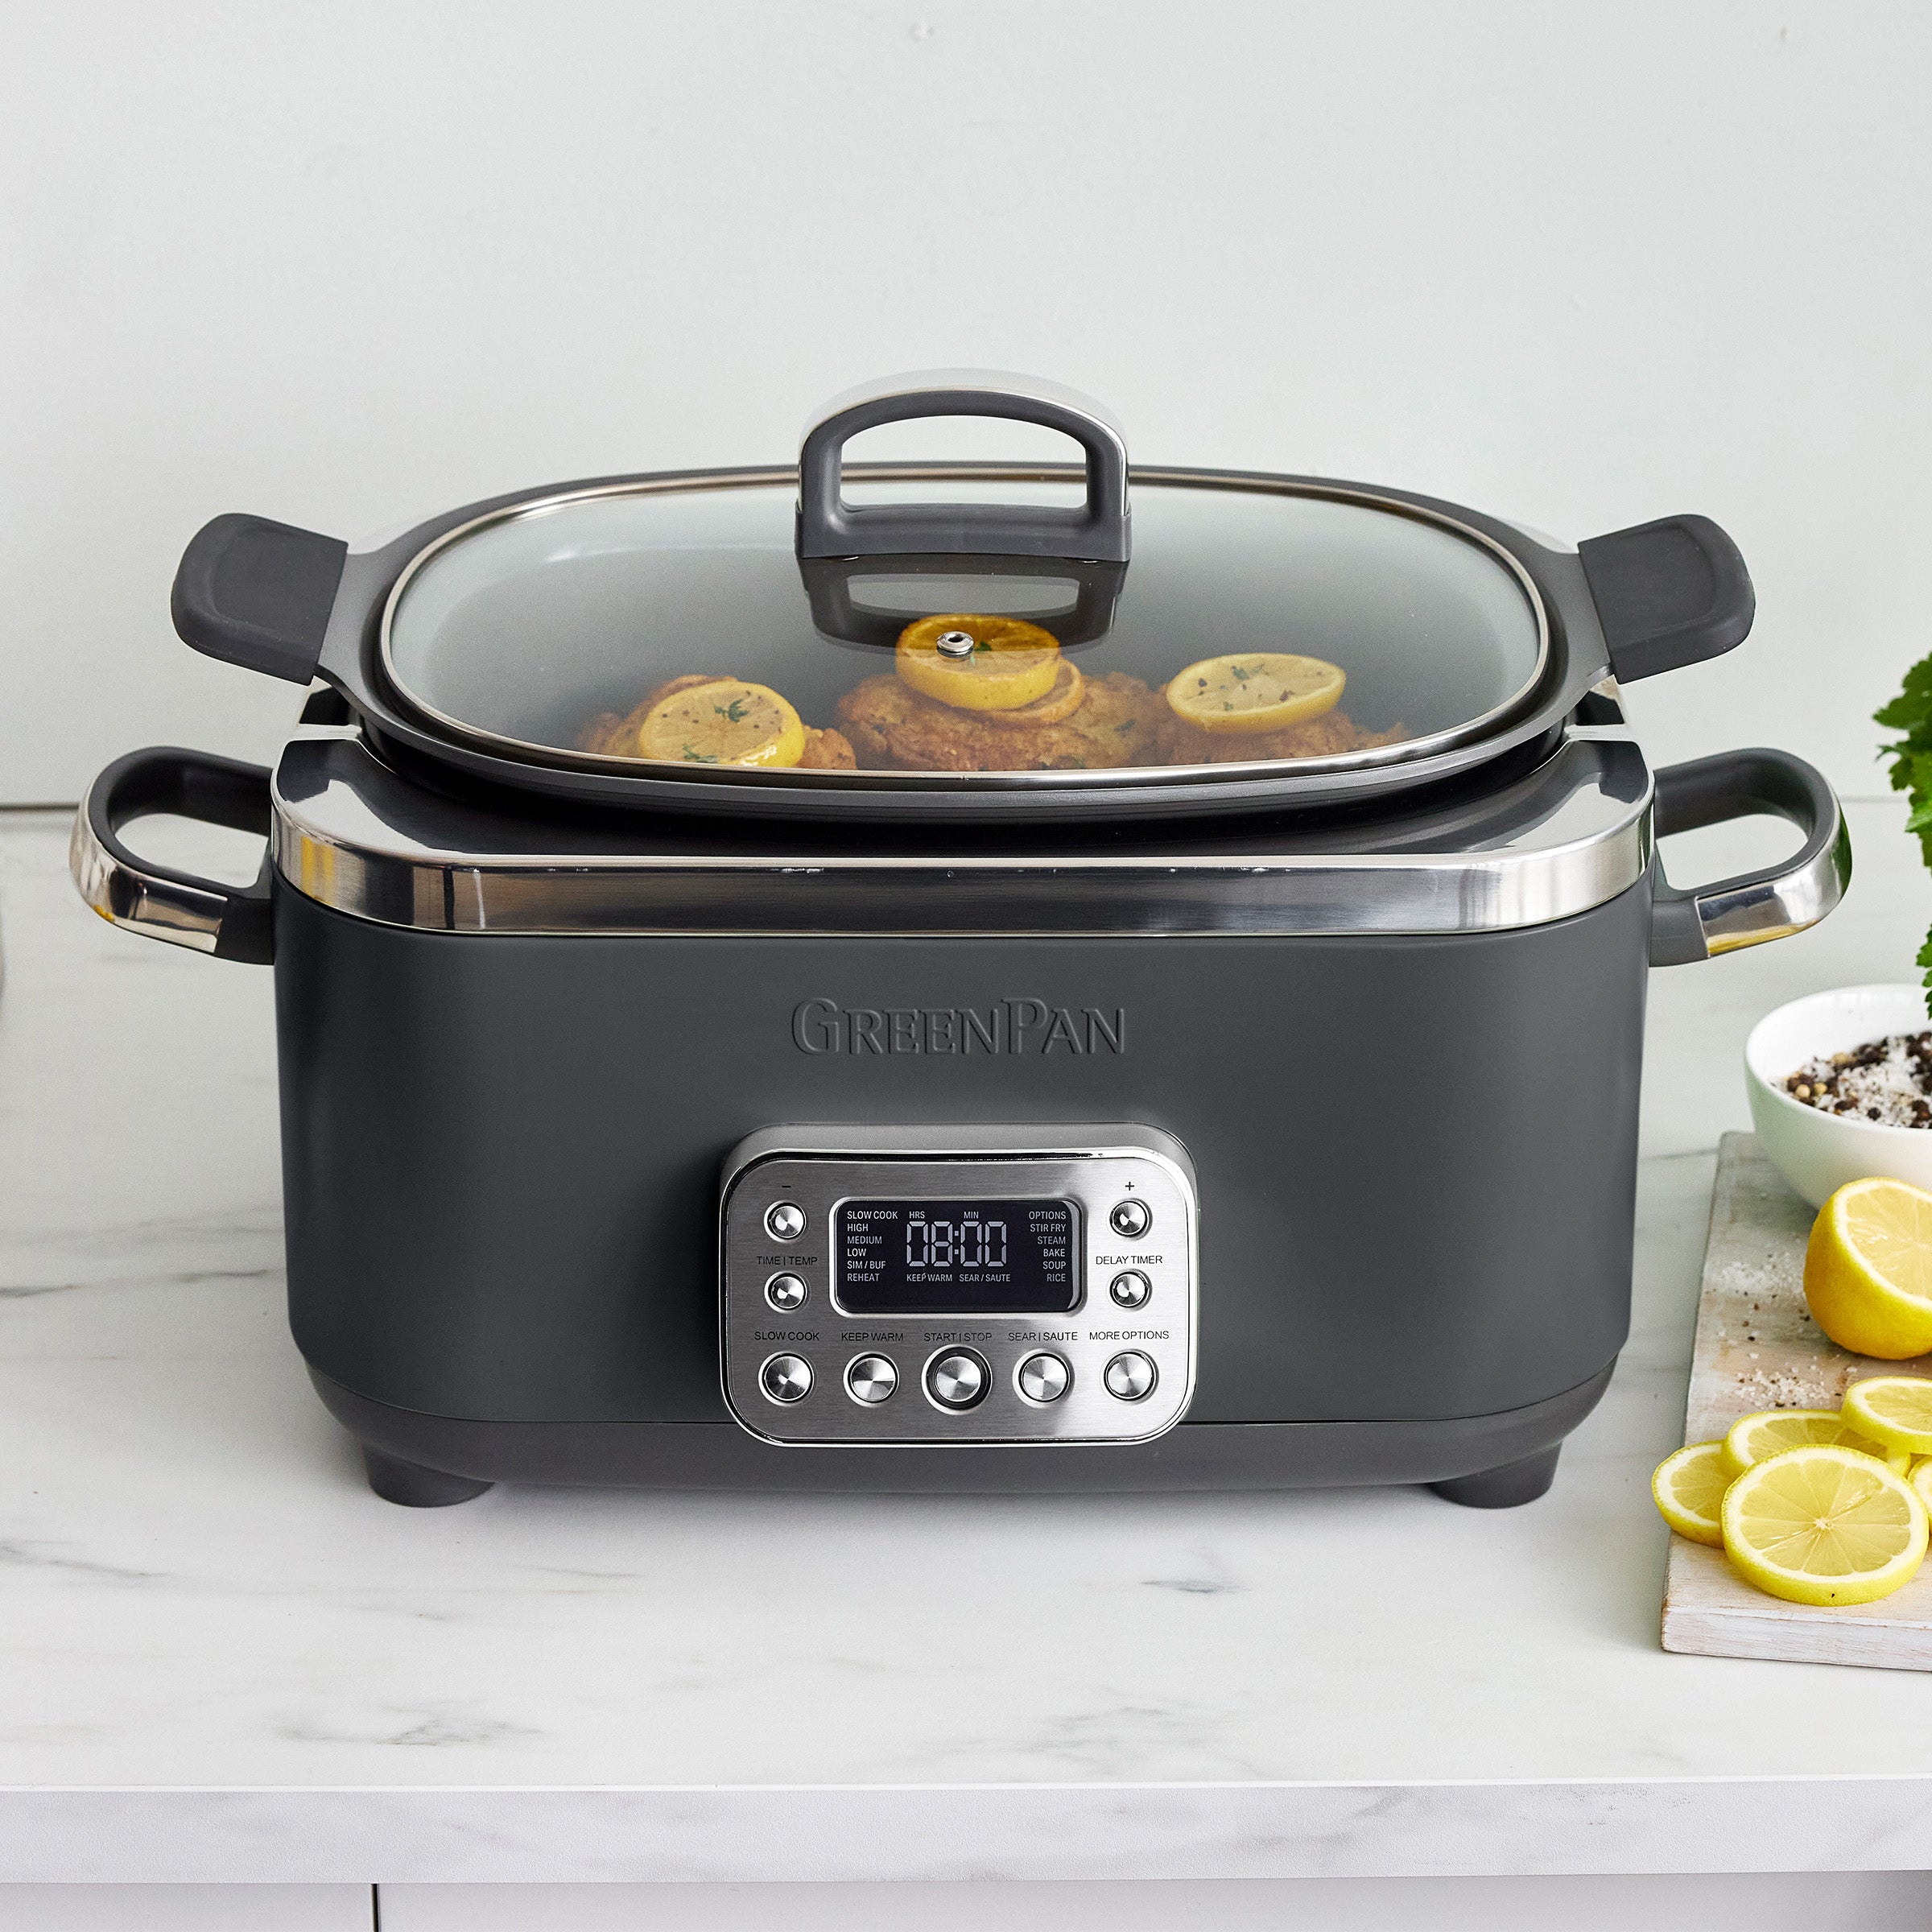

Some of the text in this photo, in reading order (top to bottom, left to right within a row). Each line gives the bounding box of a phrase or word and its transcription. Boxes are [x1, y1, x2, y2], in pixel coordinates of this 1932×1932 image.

[847, 1211, 898, 1220] SLOW COOK
[909, 1211, 926, 1220] HRS
[964, 1211, 979, 1220] MIN
[1029, 1211, 1067, 1220] OPTIONS
[847, 1224, 869, 1232] HIGH
[1030, 1224, 1067, 1232] STIR FRY
[847, 1236, 882, 1245] MEDIUM
[906, 1221, 1006, 1267] 08:00
[1037, 1236, 1066, 1245] STEAM
[847, 1249, 866, 1257] LOW
[1043, 1249, 1066, 1257] BAKE
[757, 1256, 780, 1265] TIME
[790, 1256, 818, 1265] TEMP
[1096, 1255, 1162, 1265] DELAY TIMER
[847, 1261, 864, 1269] SIM
[869, 1261, 886, 1269] BUF
[1042, 1261, 1067, 1269] SOUP
[847, 1274, 879, 1282] REHEAT
[906, 1273, 952, 1282] KEEP WARM
[959, 1274, 980, 1282] SEAR
[985, 1274, 1010, 1282] SAUTE
[1046, 1274, 1066, 1282] RICE
[754, 1331, 819, 1340] SLOW COOK
[841, 1332, 904, 1341] KEEP WARM
[923, 1332, 956, 1341] START
[964, 1332, 993, 1341] STOP
[1008, 1332, 1036, 1341] SEAR
[1042, 1331, 1078, 1341] SAUTE
[1089, 1331, 1170, 1340] MORE OPTIONS
